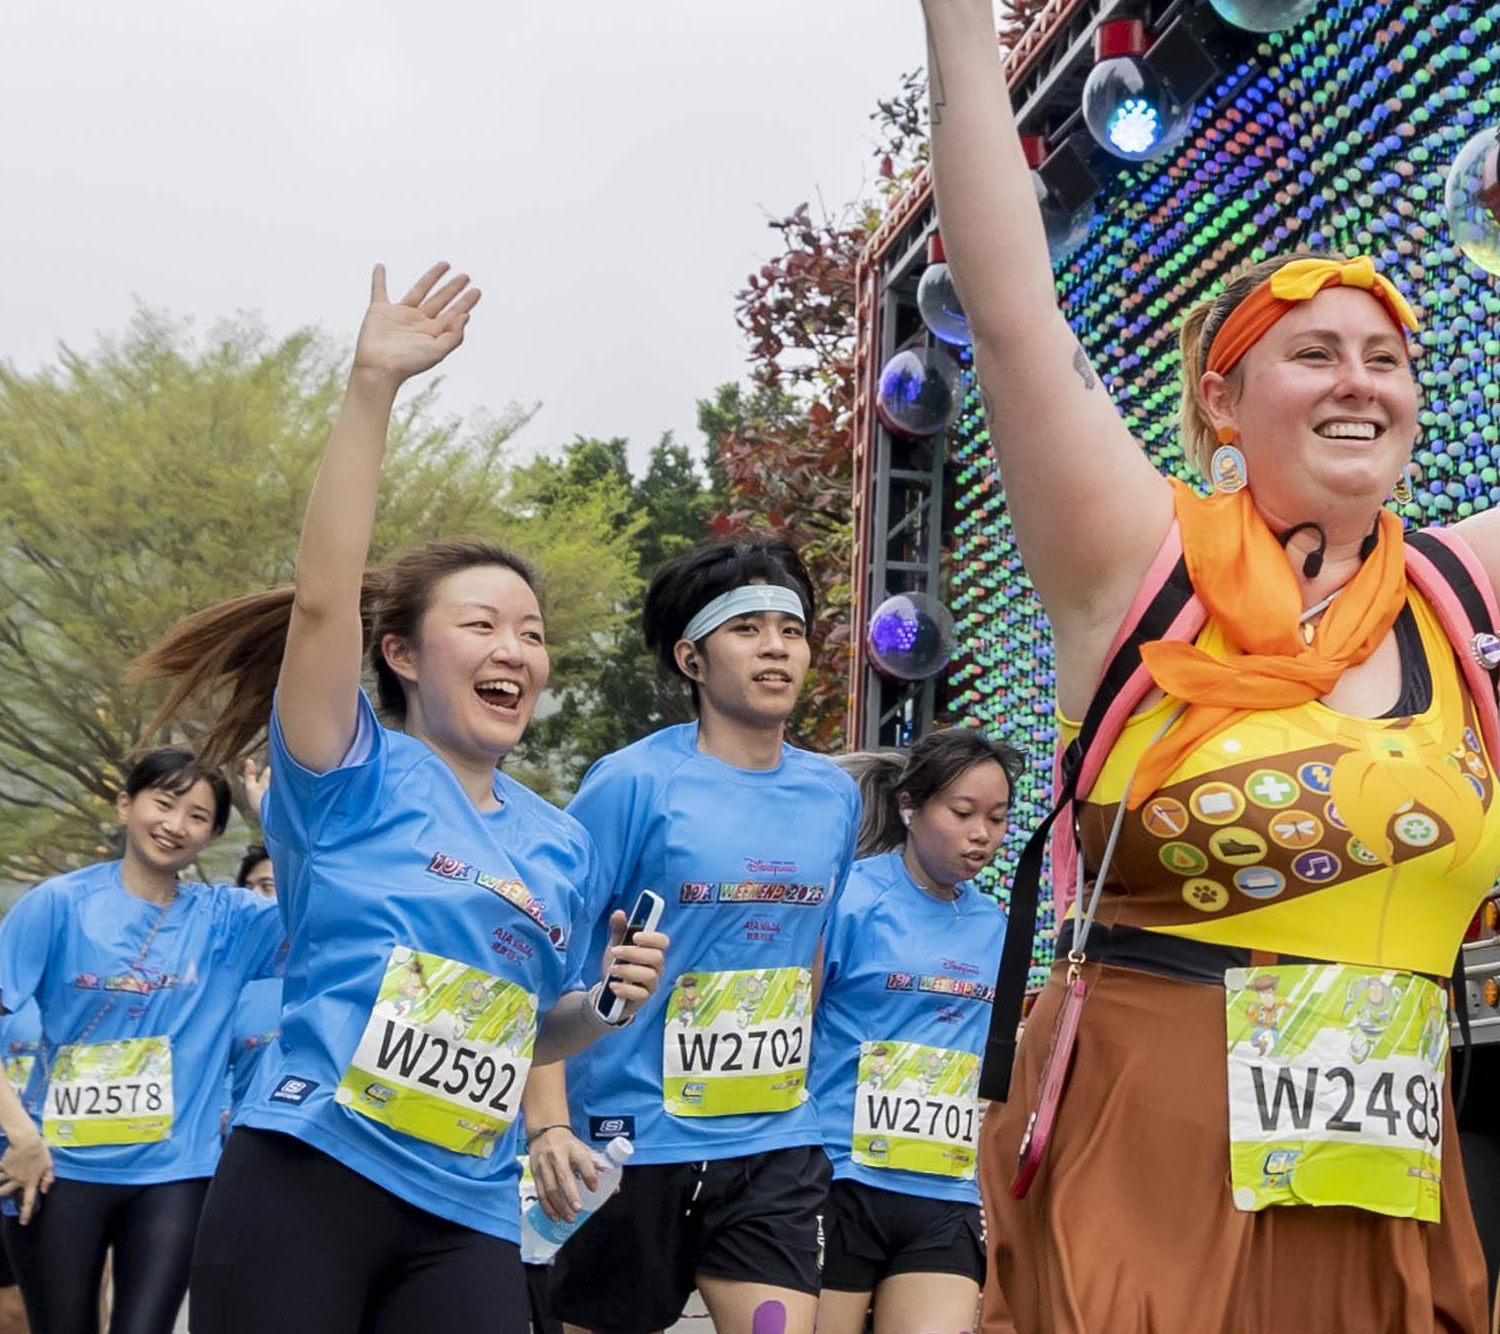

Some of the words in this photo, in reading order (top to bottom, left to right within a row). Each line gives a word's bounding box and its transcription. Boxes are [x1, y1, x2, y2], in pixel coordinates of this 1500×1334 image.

[375, 1019, 517, 1113] W2592
[677, 1026, 804, 1072] W2702
[54, 1082, 163, 1116] W2578
[867, 1094, 974, 1143] W2701
